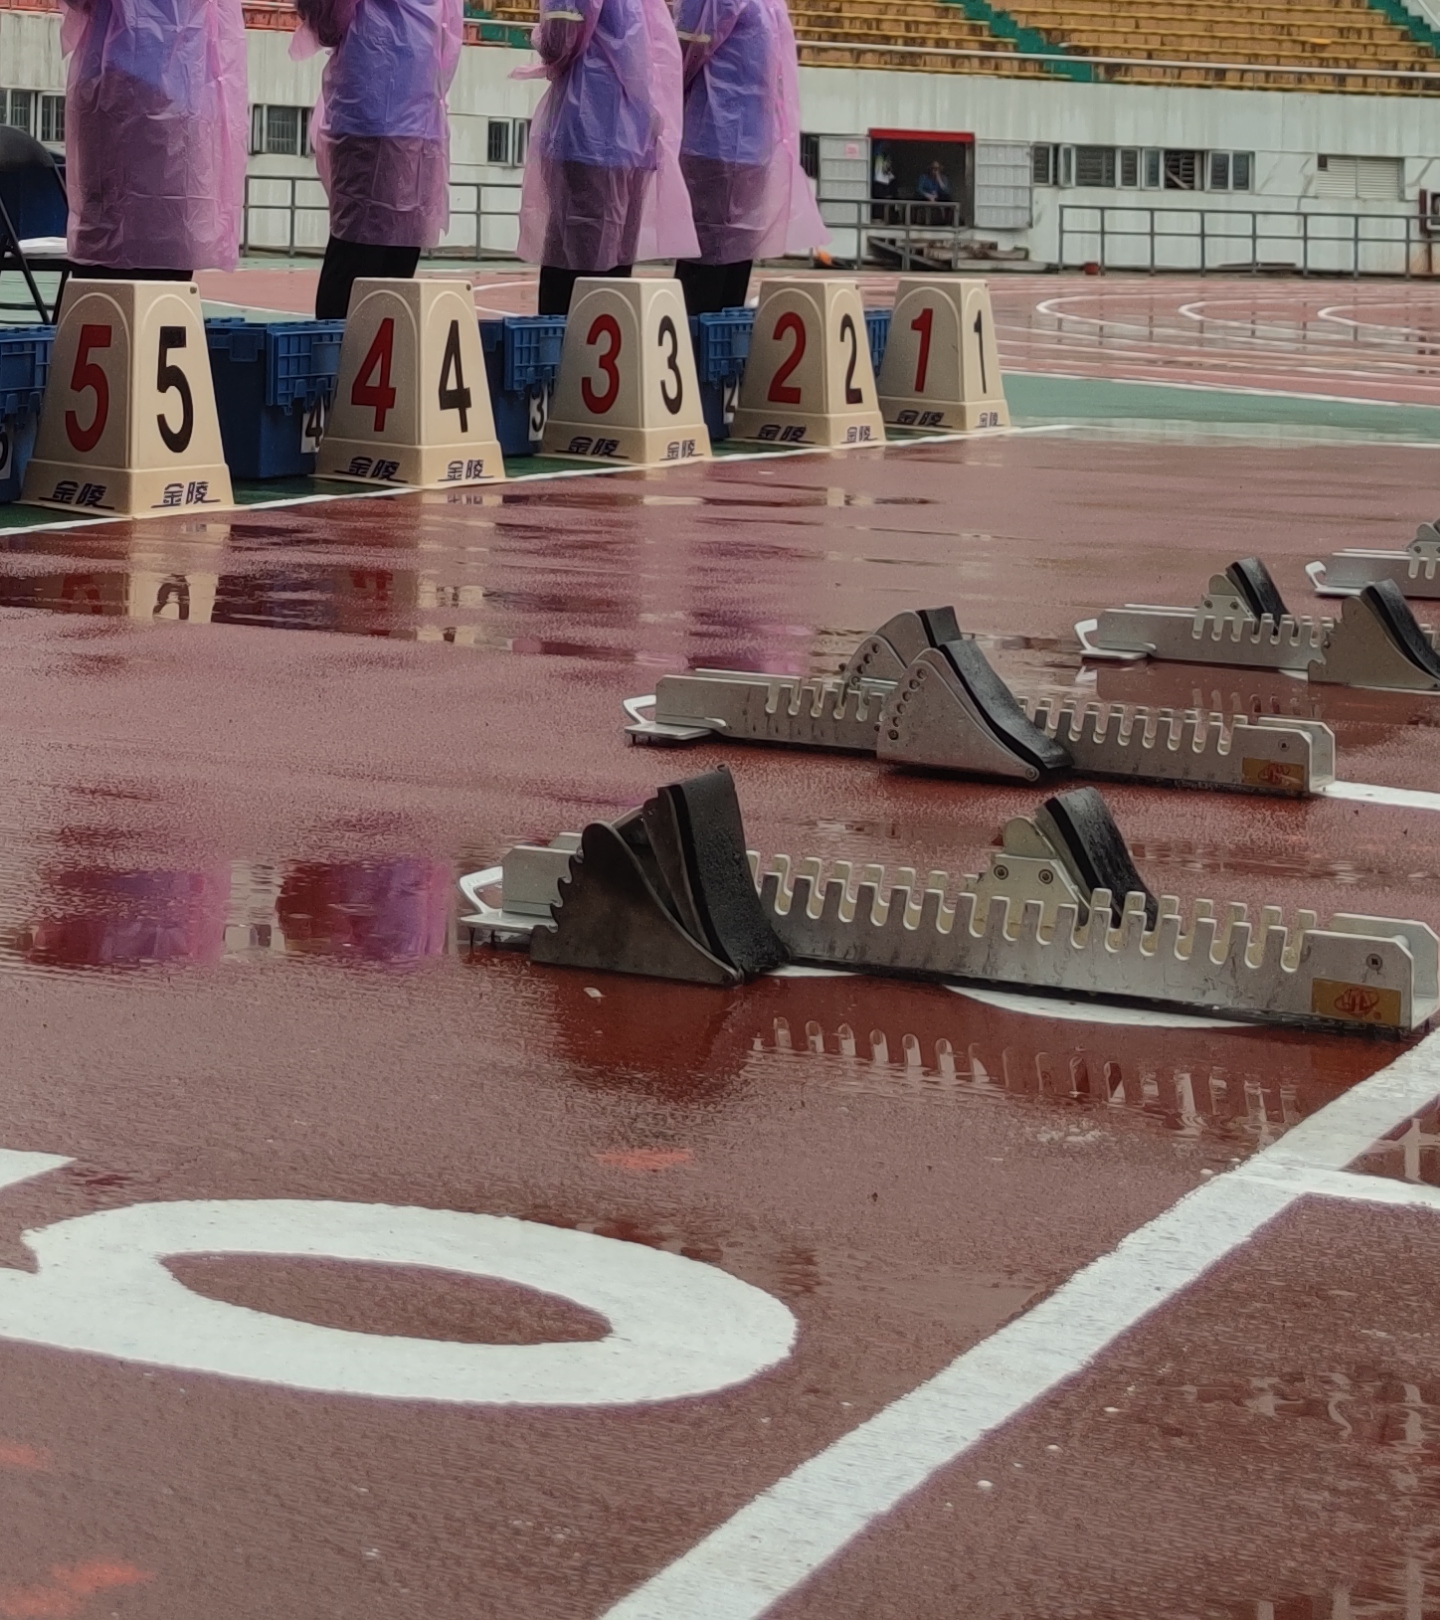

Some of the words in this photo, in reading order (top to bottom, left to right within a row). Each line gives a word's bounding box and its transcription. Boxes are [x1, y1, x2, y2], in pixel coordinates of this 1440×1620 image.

[65, 324, 113, 453] 5
[155, 326, 194, 454] 5
[351, 317, 397, 433] 4
[438, 319, 472, 434] 4
[581, 313, 622, 414] 3
[657, 315, 683, 415] 3
[767, 312, 807, 405] 2
[839, 313, 864, 405] 2
[910, 308, 934, 393] 1
[973, 309, 988, 394] 1
[305, 390, 323, 449] 4
[659, 439, 704, 461] 金陵
[839, 425, 878, 443] 金陵
[975, 412, 1005, 428] 金陵
[151, 481, 221, 509] 金陵
[437, 459, 495, 482] 金陵
